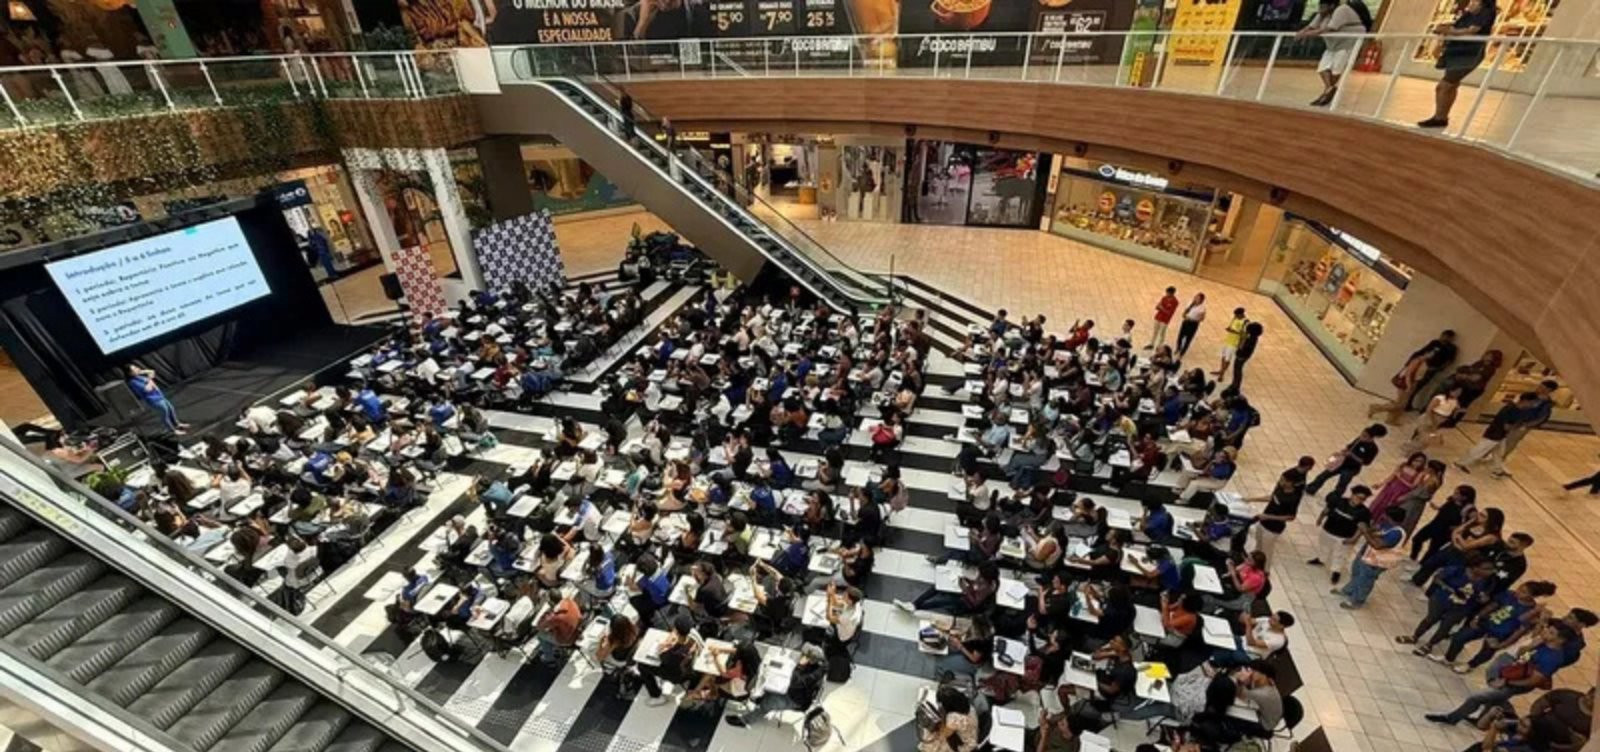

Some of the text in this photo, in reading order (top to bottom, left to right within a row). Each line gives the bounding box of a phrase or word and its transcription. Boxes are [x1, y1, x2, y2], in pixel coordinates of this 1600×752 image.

[553, 12, 561, 26] A
[562, 11, 599, 27] NOSSA
[760, 11, 793, 31] 7,90
[537, 27, 613, 43] ESPECIALIDADE
